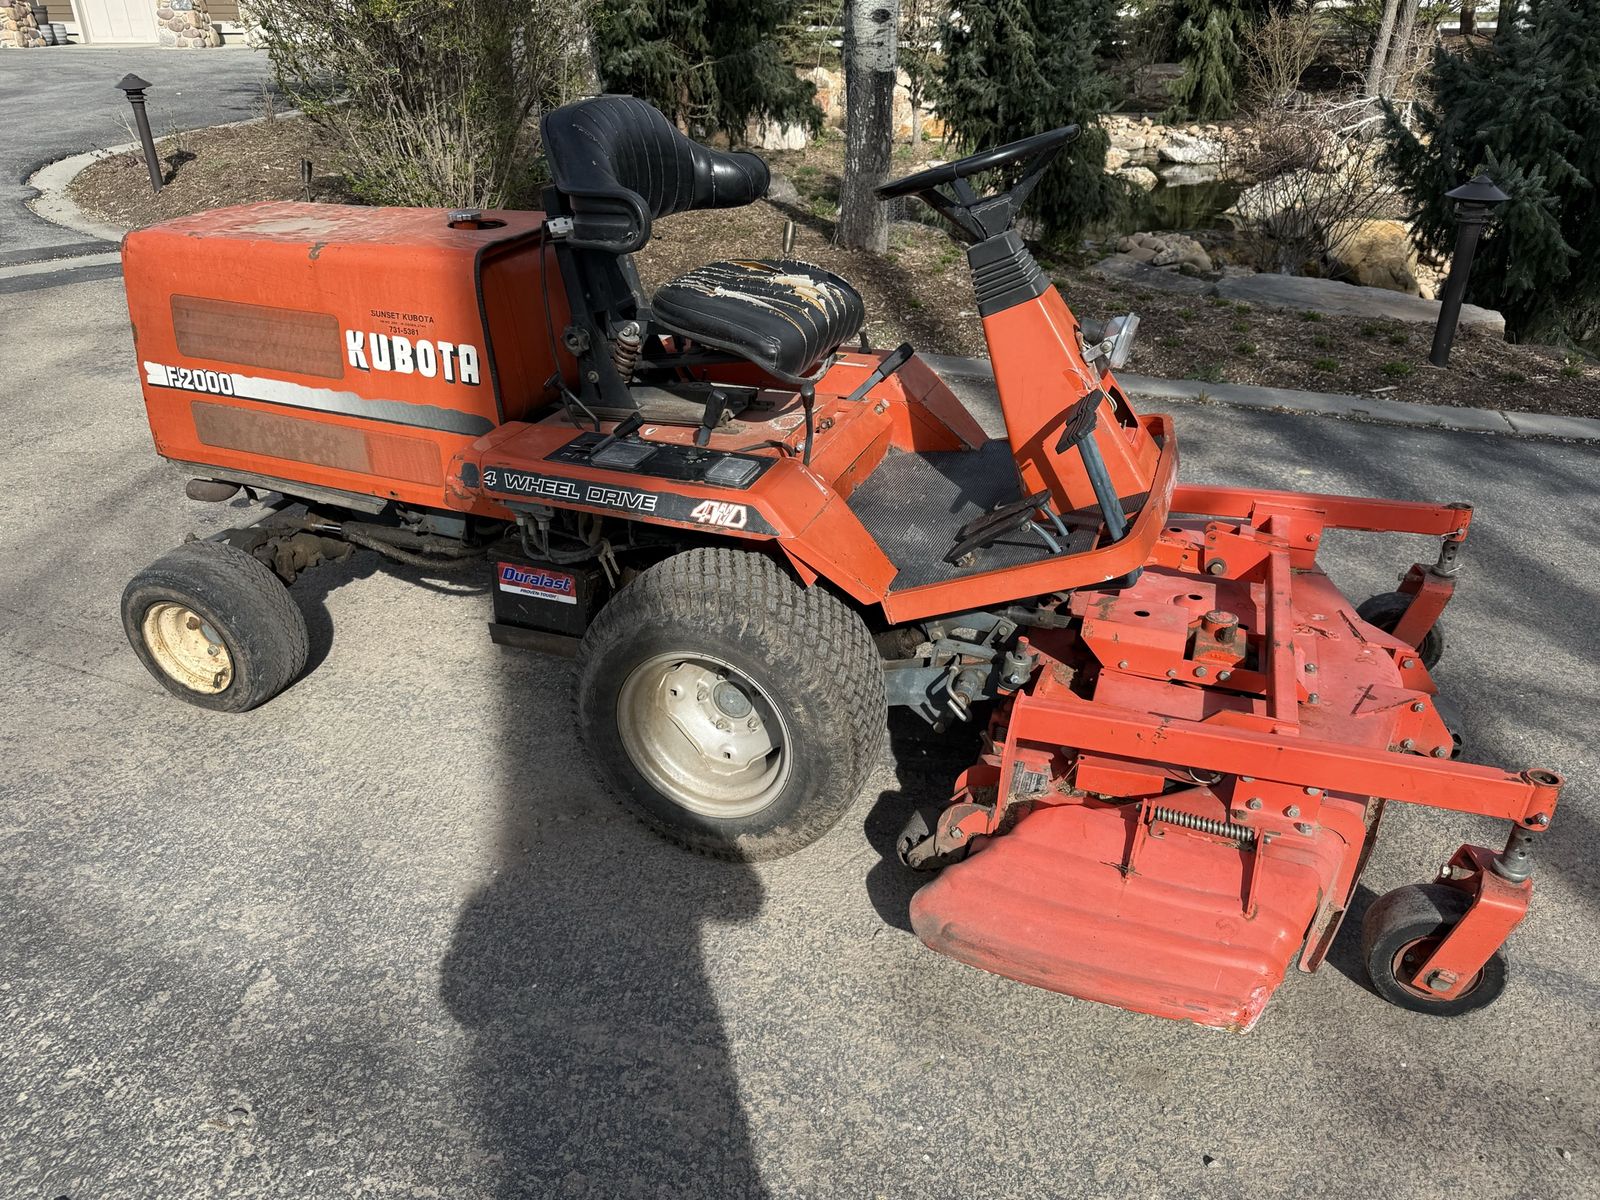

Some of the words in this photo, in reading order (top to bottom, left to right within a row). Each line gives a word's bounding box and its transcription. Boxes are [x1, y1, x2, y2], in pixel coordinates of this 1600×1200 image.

[370, 309, 400, 320] SUNSET
[402, 313, 435, 324] KUBOTA
[388, 325, 419, 336] 731-5381
[345, 329, 480, 386] KUBOTA
[483, 470, 497, 486] 4
[504, 473, 580, 500] WHEEL
[586, 486, 658, 512] DRIVE
[690, 500, 747, 529] 4WD
[502, 566, 571, 592] Duralast
